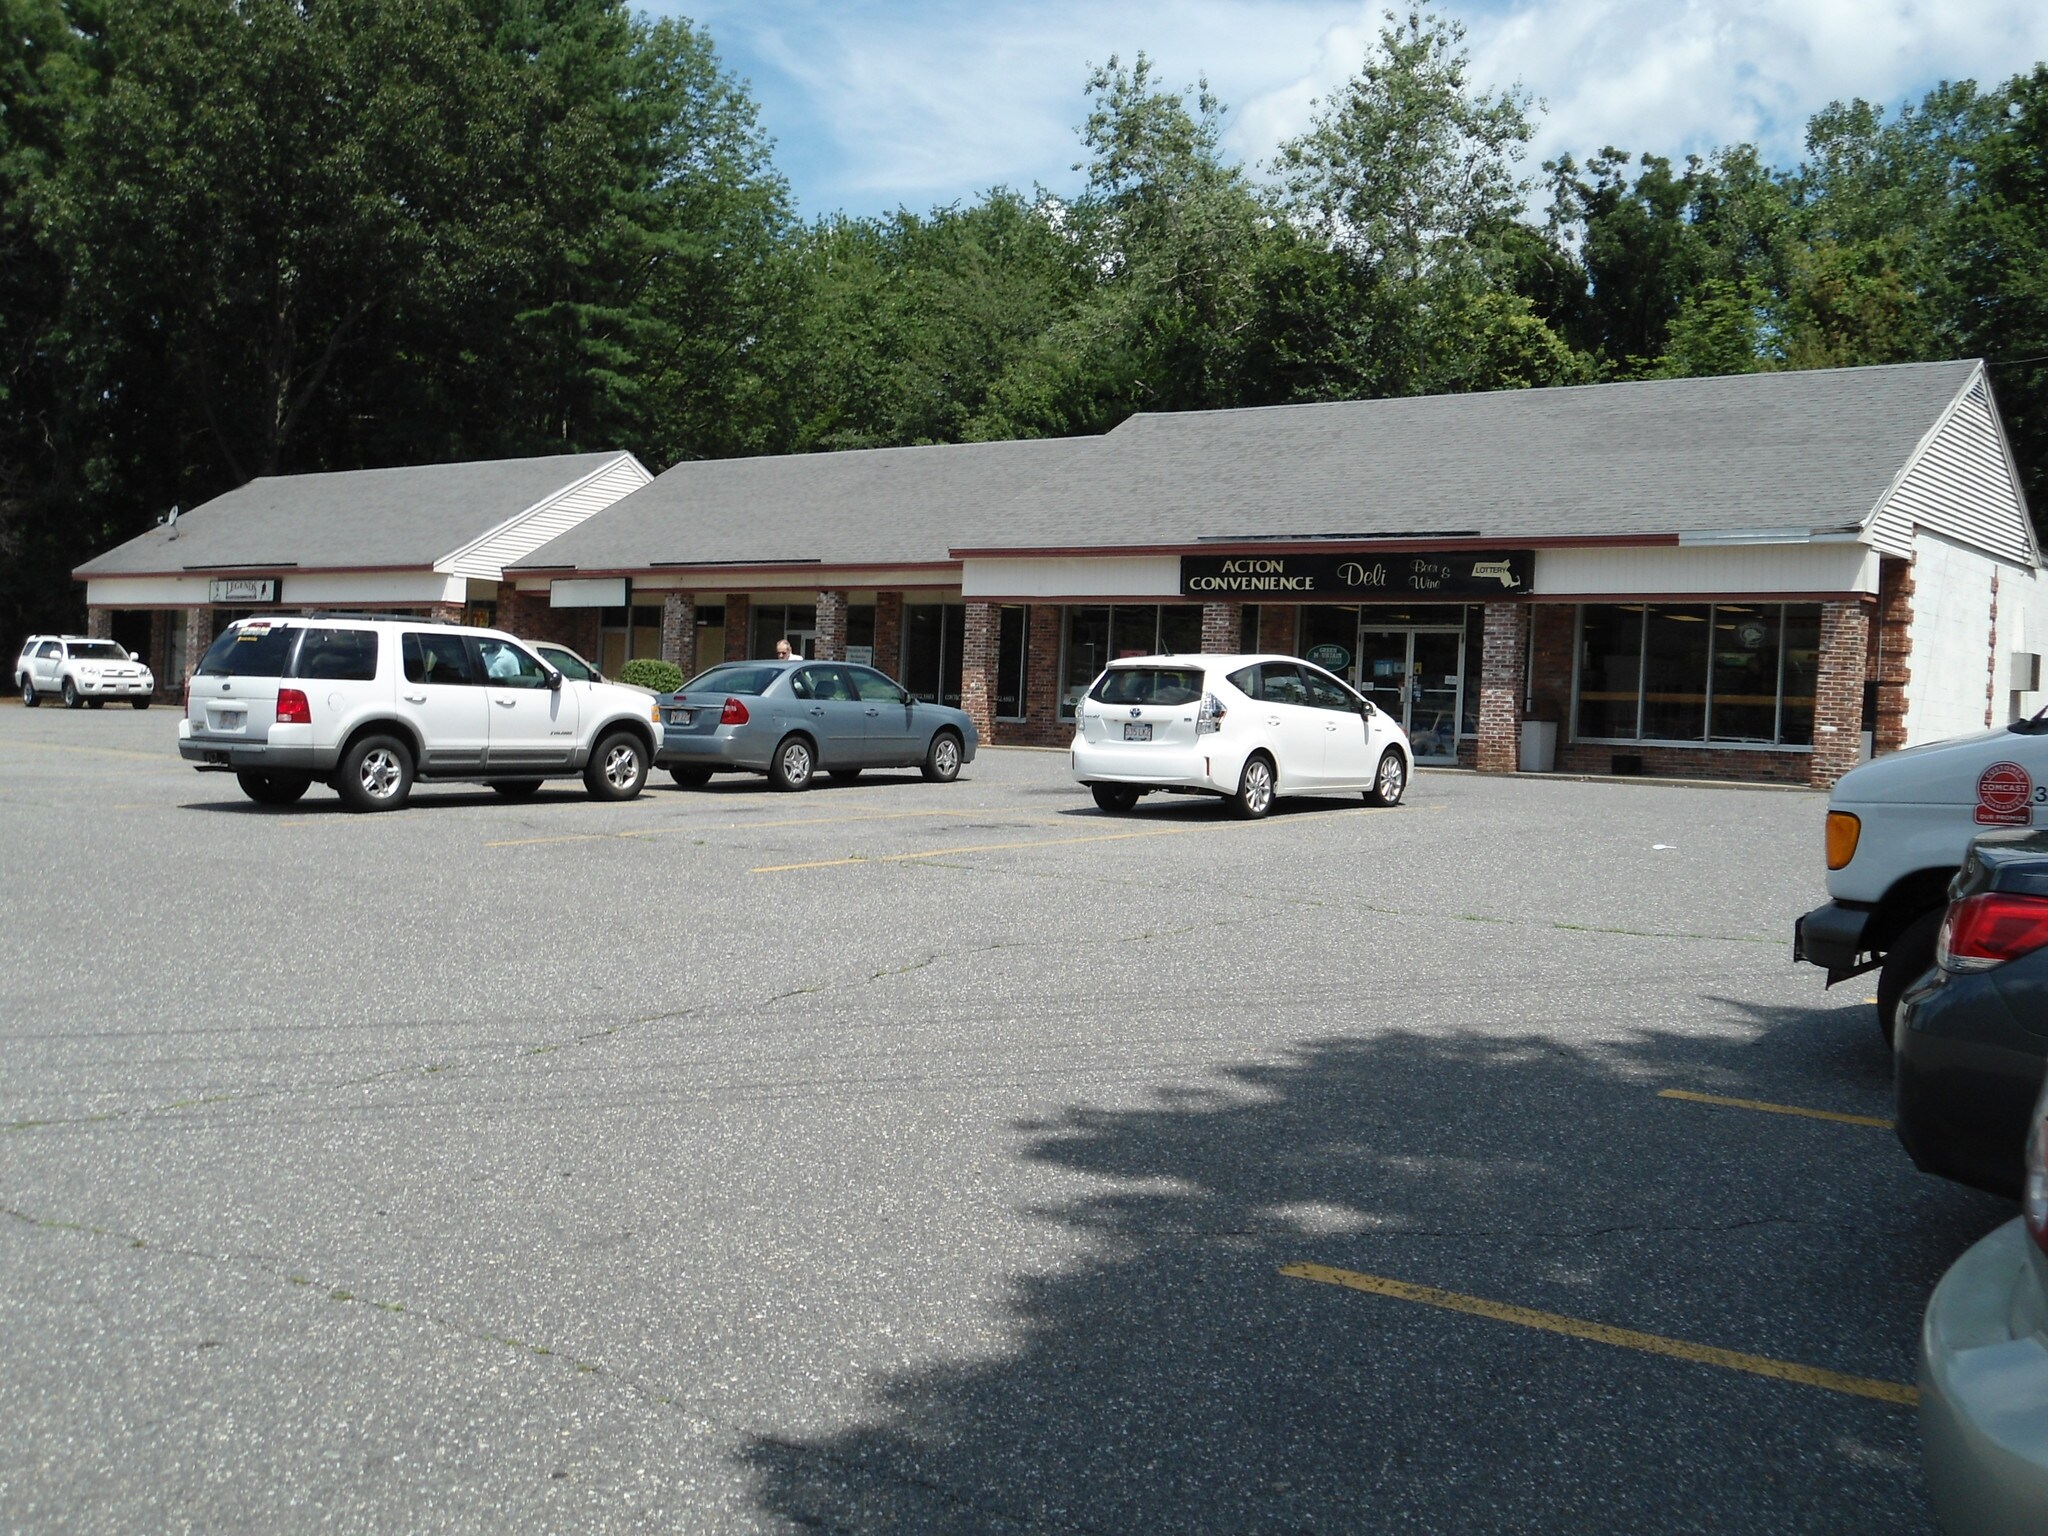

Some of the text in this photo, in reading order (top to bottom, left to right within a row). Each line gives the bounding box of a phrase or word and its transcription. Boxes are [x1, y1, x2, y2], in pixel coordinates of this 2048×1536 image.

[1221, 559, 1284, 573] ACTON
[1410, 559, 1438, 573] Beer
[1475, 566, 1507, 574] LOTTERY
[1336, 561, 1387, 587] Deli
[1189, 576, 1315, 591] CONVENIENCE
[1408, 575, 1441, 590] Wine
[1985, 765, 2025, 779] CUSTOMER
[1981, 783, 2028, 792] COMCAST
[2035, 786, 2047, 802] 3
[1996, 814, 2027, 822] PROMISE
